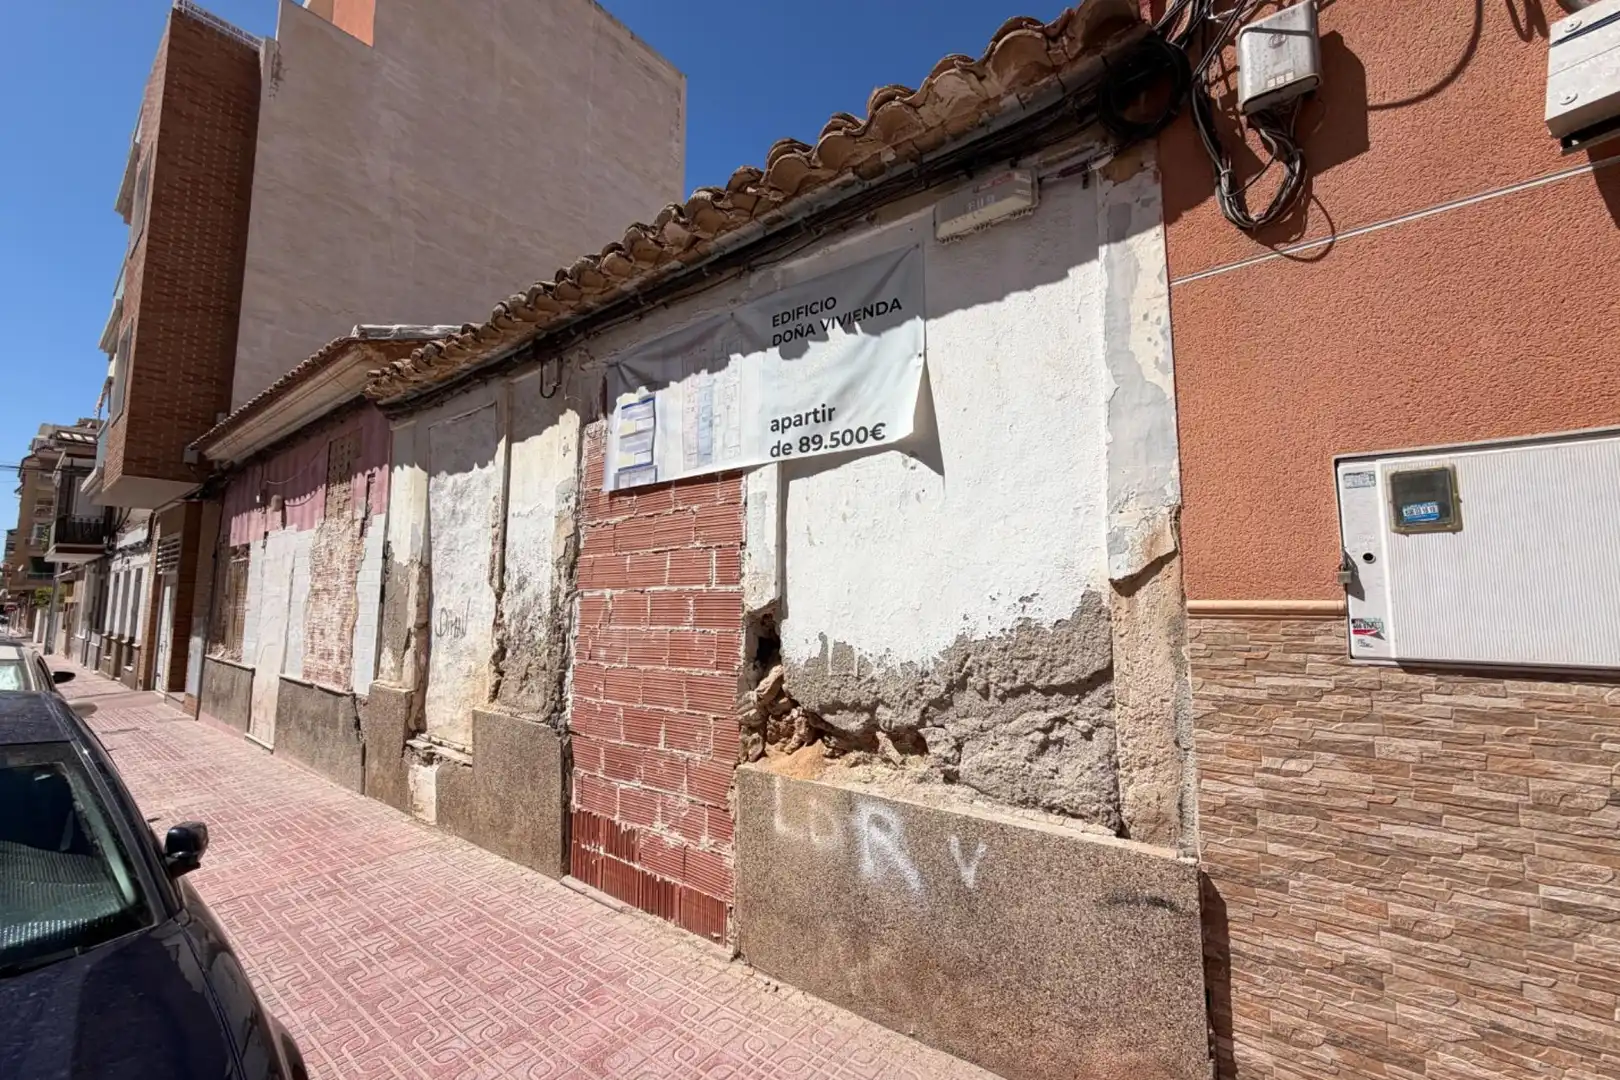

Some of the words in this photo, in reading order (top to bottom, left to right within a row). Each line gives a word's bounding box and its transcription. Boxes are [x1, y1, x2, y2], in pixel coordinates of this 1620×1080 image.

[772, 296, 837, 328] EDIFICIO
[772, 323, 816, 347] DOÑA
[820, 297, 902, 332] VIVIENDA
[770, 403, 836, 434] apartir
[770, 440, 793, 458] de
[799, 422, 886, 453] 89.500€
